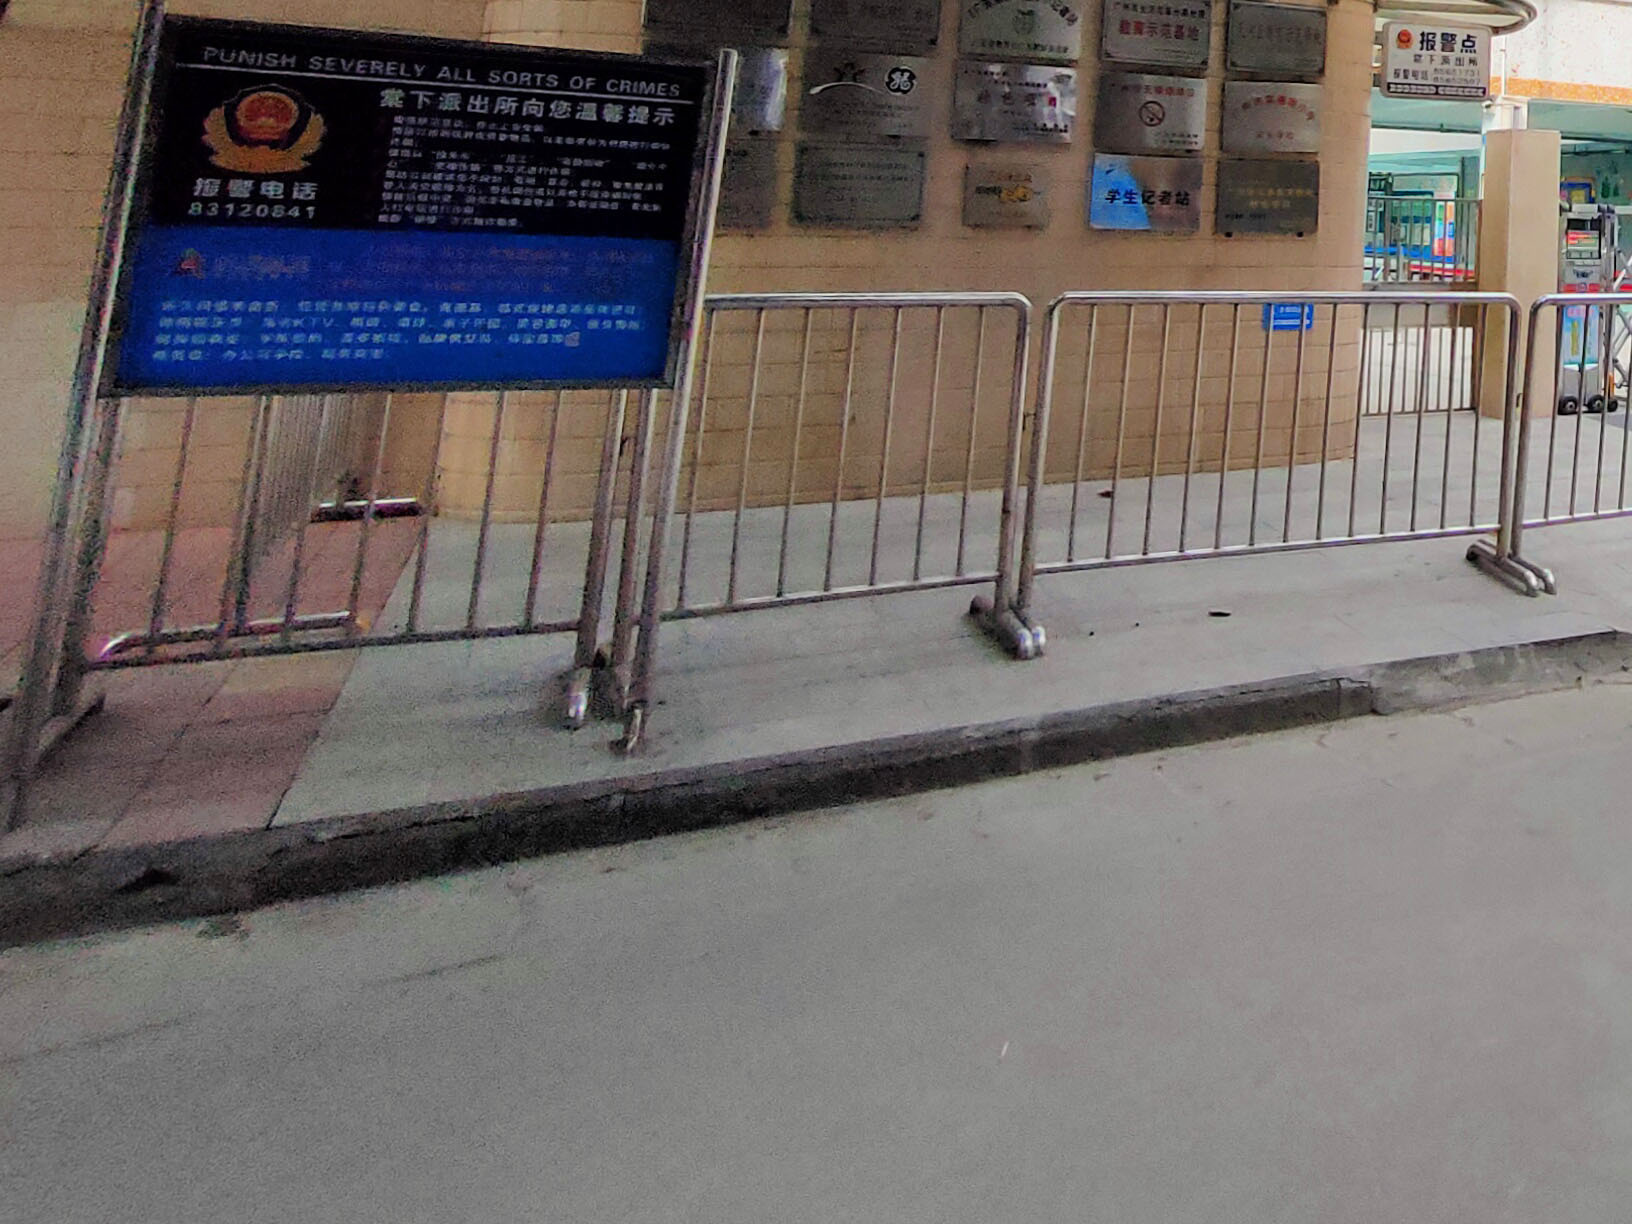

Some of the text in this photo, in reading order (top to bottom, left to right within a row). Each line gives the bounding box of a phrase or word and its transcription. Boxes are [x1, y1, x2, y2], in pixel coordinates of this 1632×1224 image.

[1419, 31, 1478, 54] 报警点
[203, 46, 681, 97] PUNISH SEVERELY ALL SORTS OF CRIMES
[379, 87, 677, 126] 棠下派出所向您温馨提示
[193, 178, 318, 200] 报警电话
[1105, 188, 1190, 206] 学生记者站
